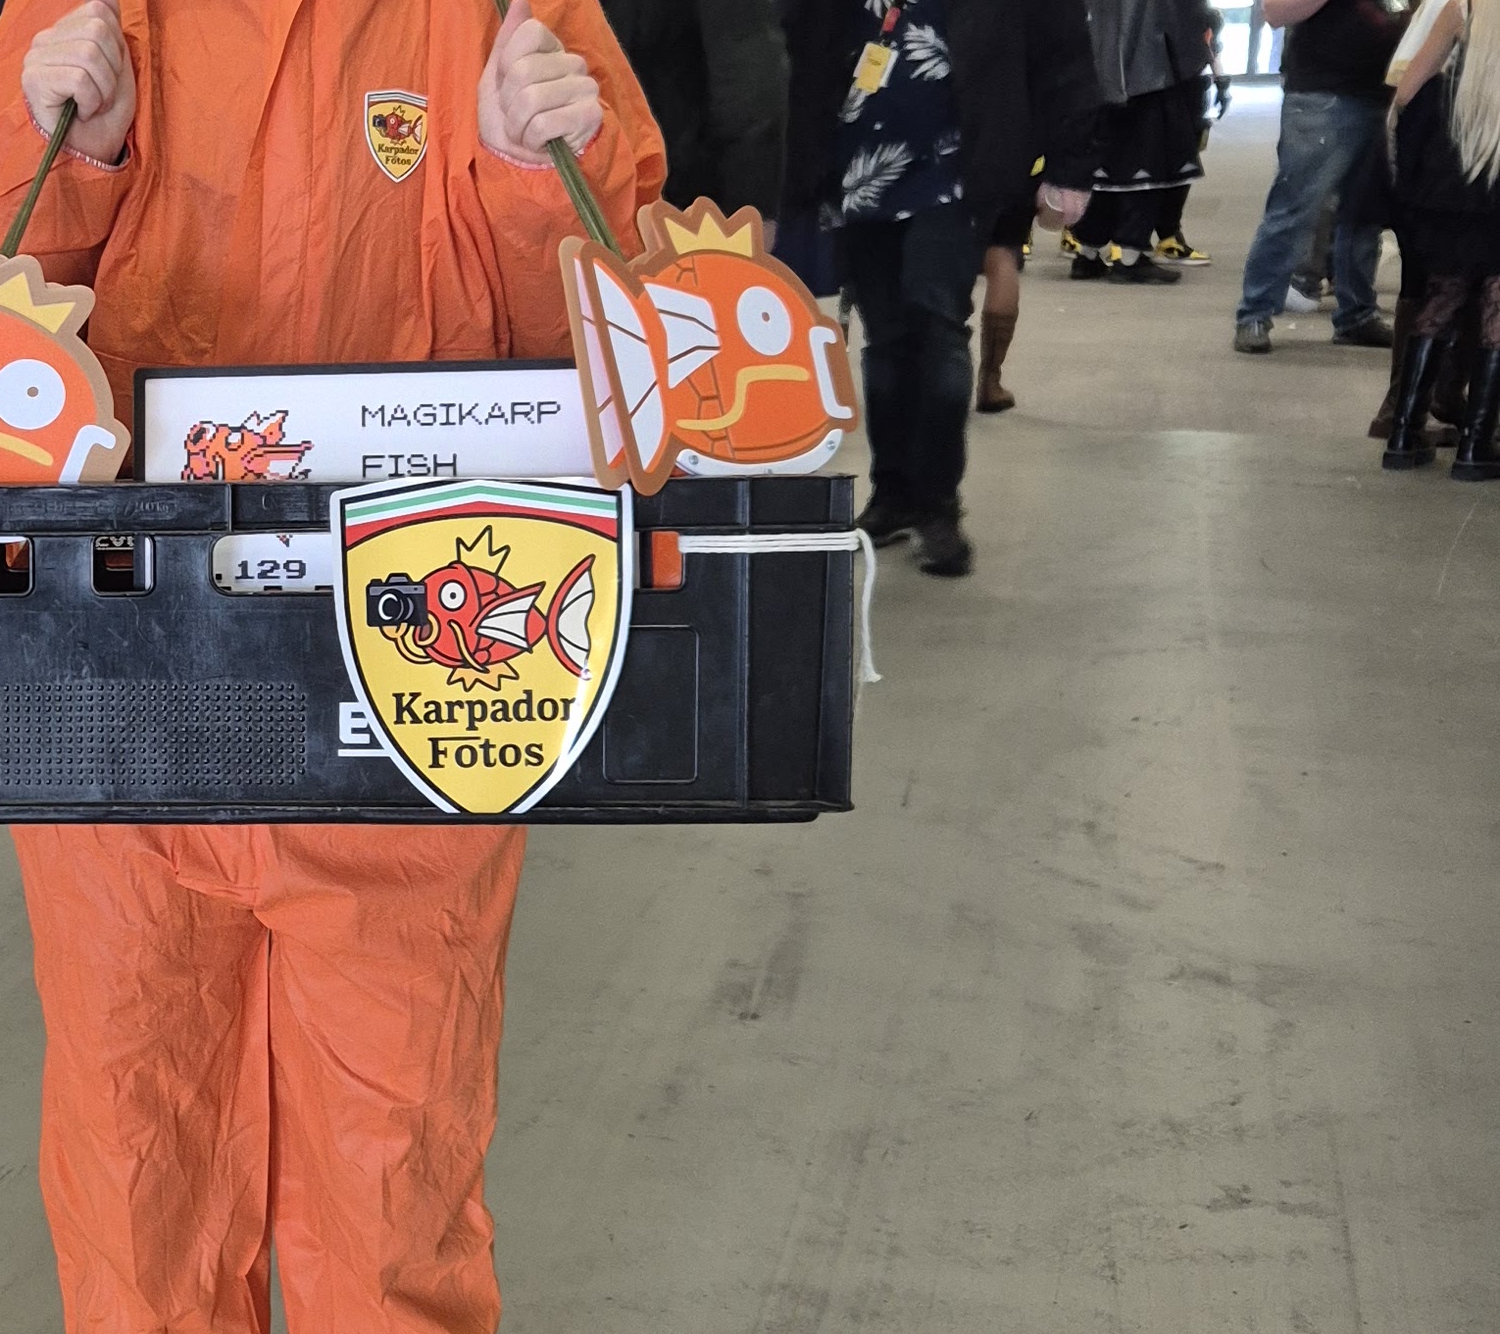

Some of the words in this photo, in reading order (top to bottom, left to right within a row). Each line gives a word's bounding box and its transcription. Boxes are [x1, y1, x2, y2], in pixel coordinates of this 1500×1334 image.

[378, 144, 419, 156] Karpador
[385, 156, 411, 166] Fotos
[361, 401, 562, 428] MAGIKARP
[362, 453, 458, 479] FISH
[234, 559, 306, 580] 129
[392, 689, 578, 731] Karpador
[428, 736, 545, 769] Fotos
